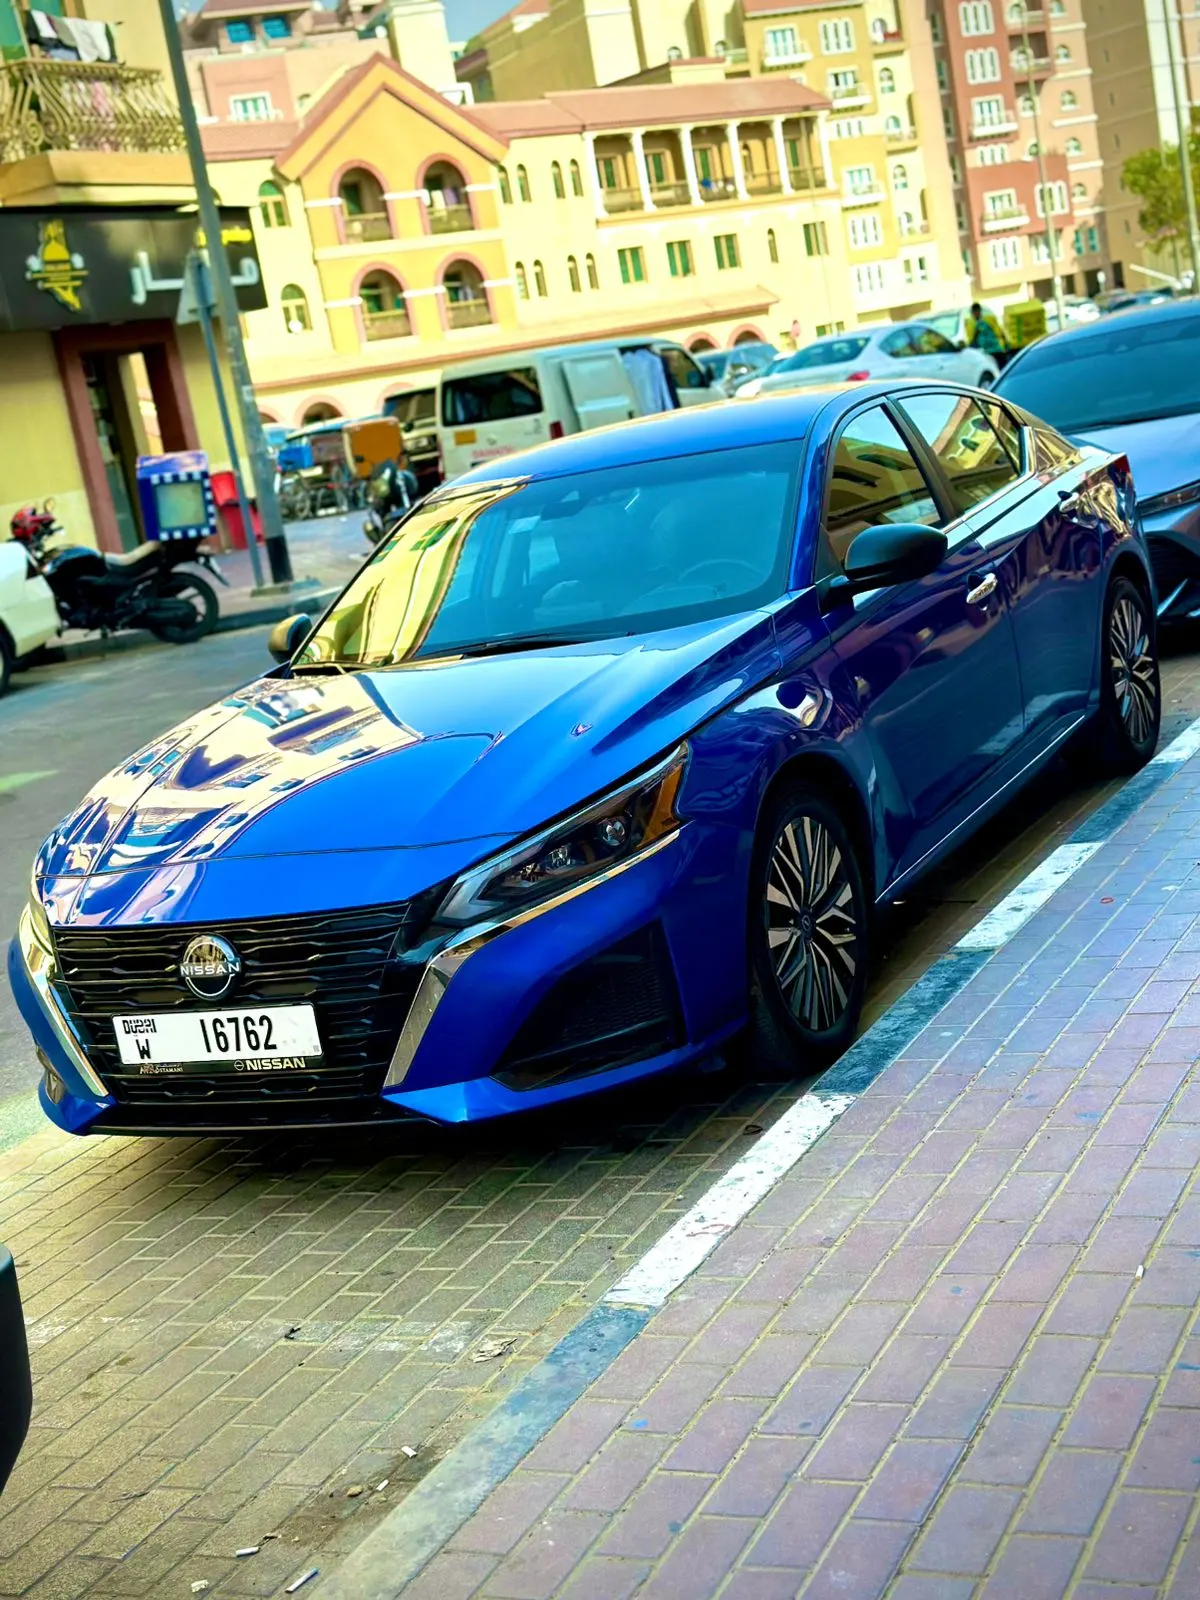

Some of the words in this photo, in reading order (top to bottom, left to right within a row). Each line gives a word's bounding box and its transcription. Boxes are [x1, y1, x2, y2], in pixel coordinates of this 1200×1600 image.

[180, 961, 240, 977] NISSAN
[200, 1015, 277, 1053] 16762
[136, 1038, 151, 1059] W
[246, 1057, 306, 1071] NISSAN
